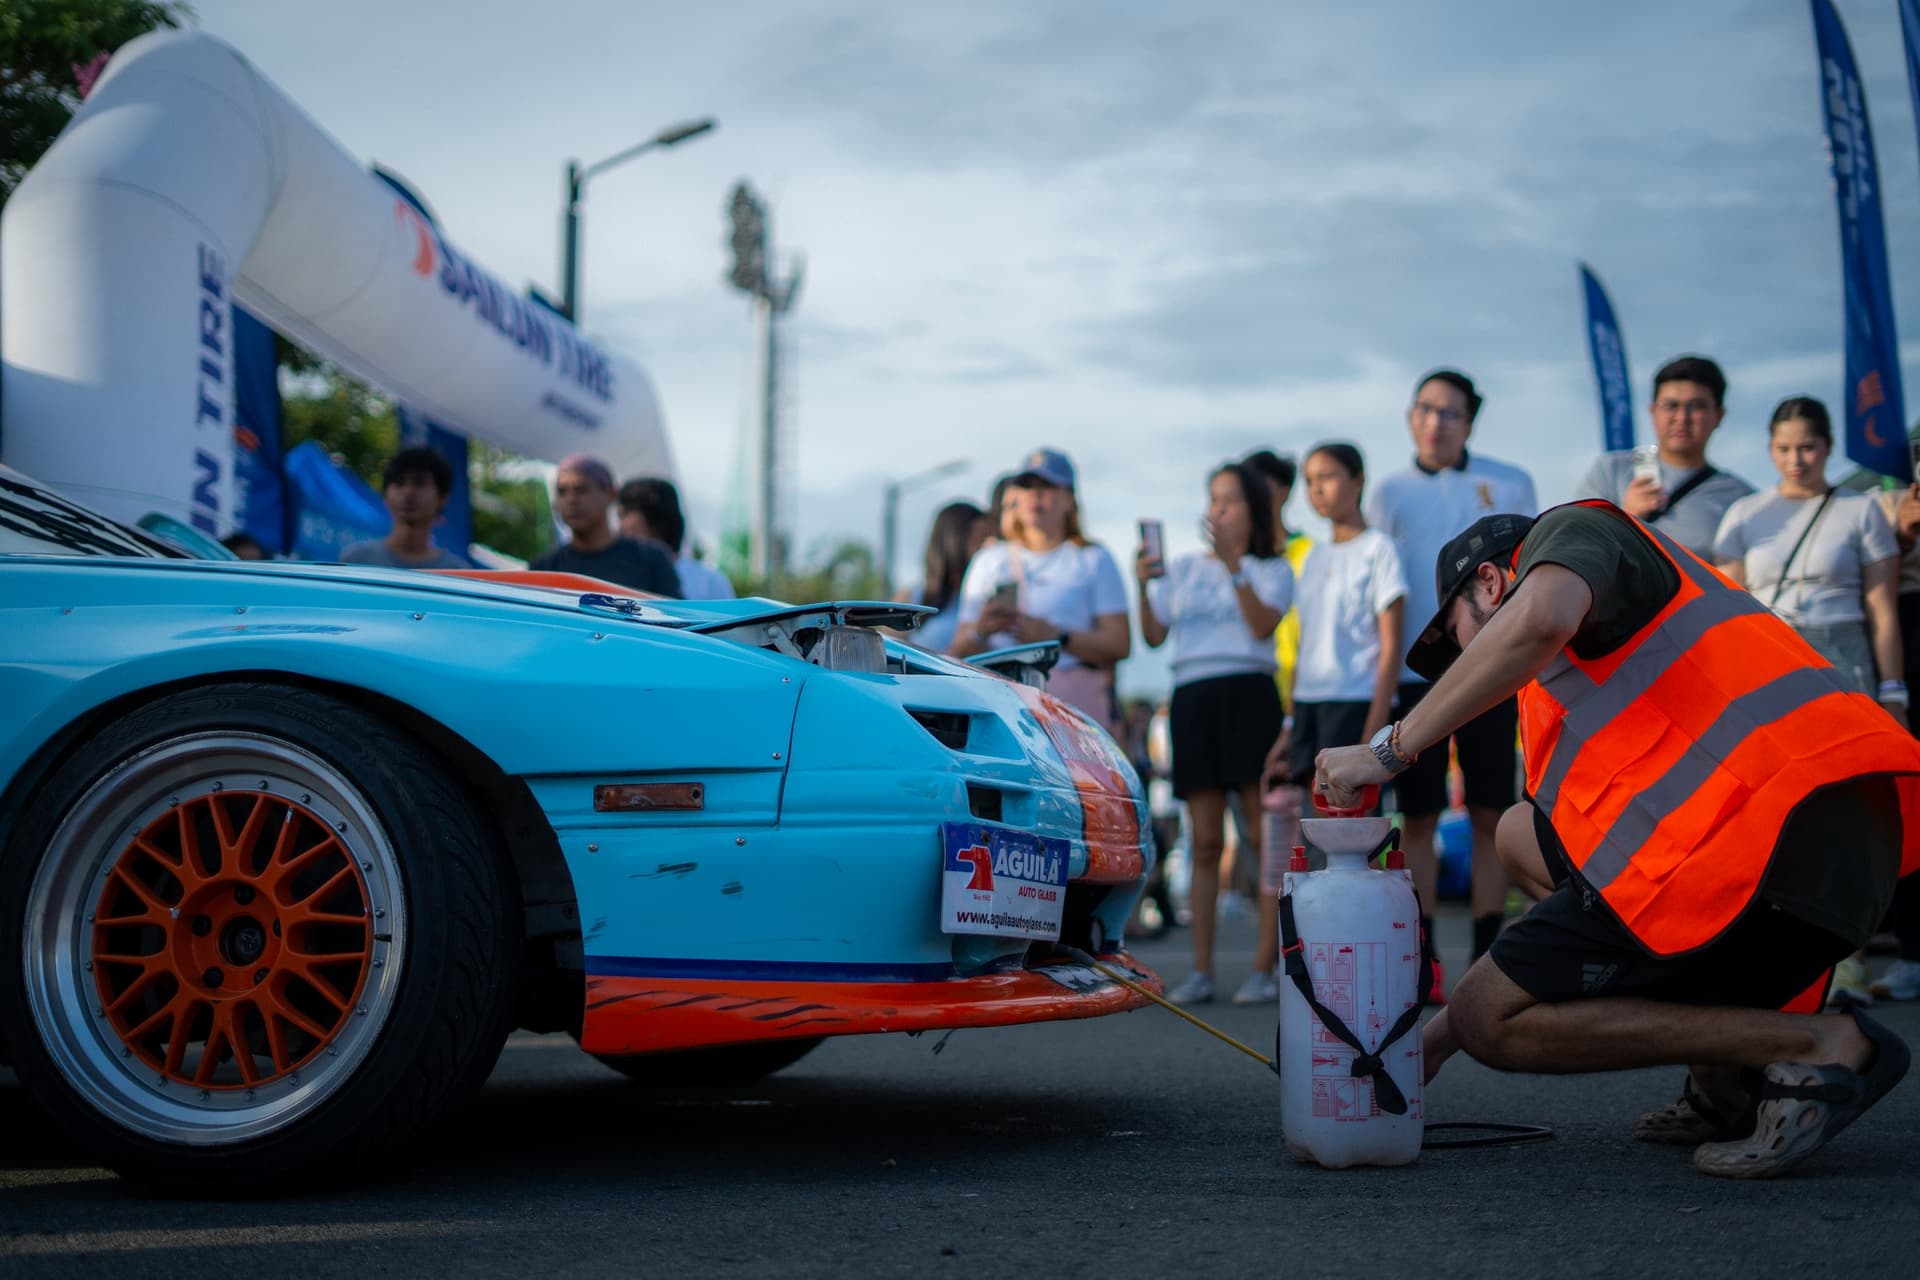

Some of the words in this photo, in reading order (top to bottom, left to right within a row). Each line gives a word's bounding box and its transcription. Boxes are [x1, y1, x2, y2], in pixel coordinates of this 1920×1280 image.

[197, 241, 224, 425] TIRE
[994, 847, 1060, 884] AGUILA
[1018, 885, 1037, 899] AUTO
[1038, 887, 1057, 902] GLASS
[957, 911, 1057, 933] www.aguilaautoglass.com
